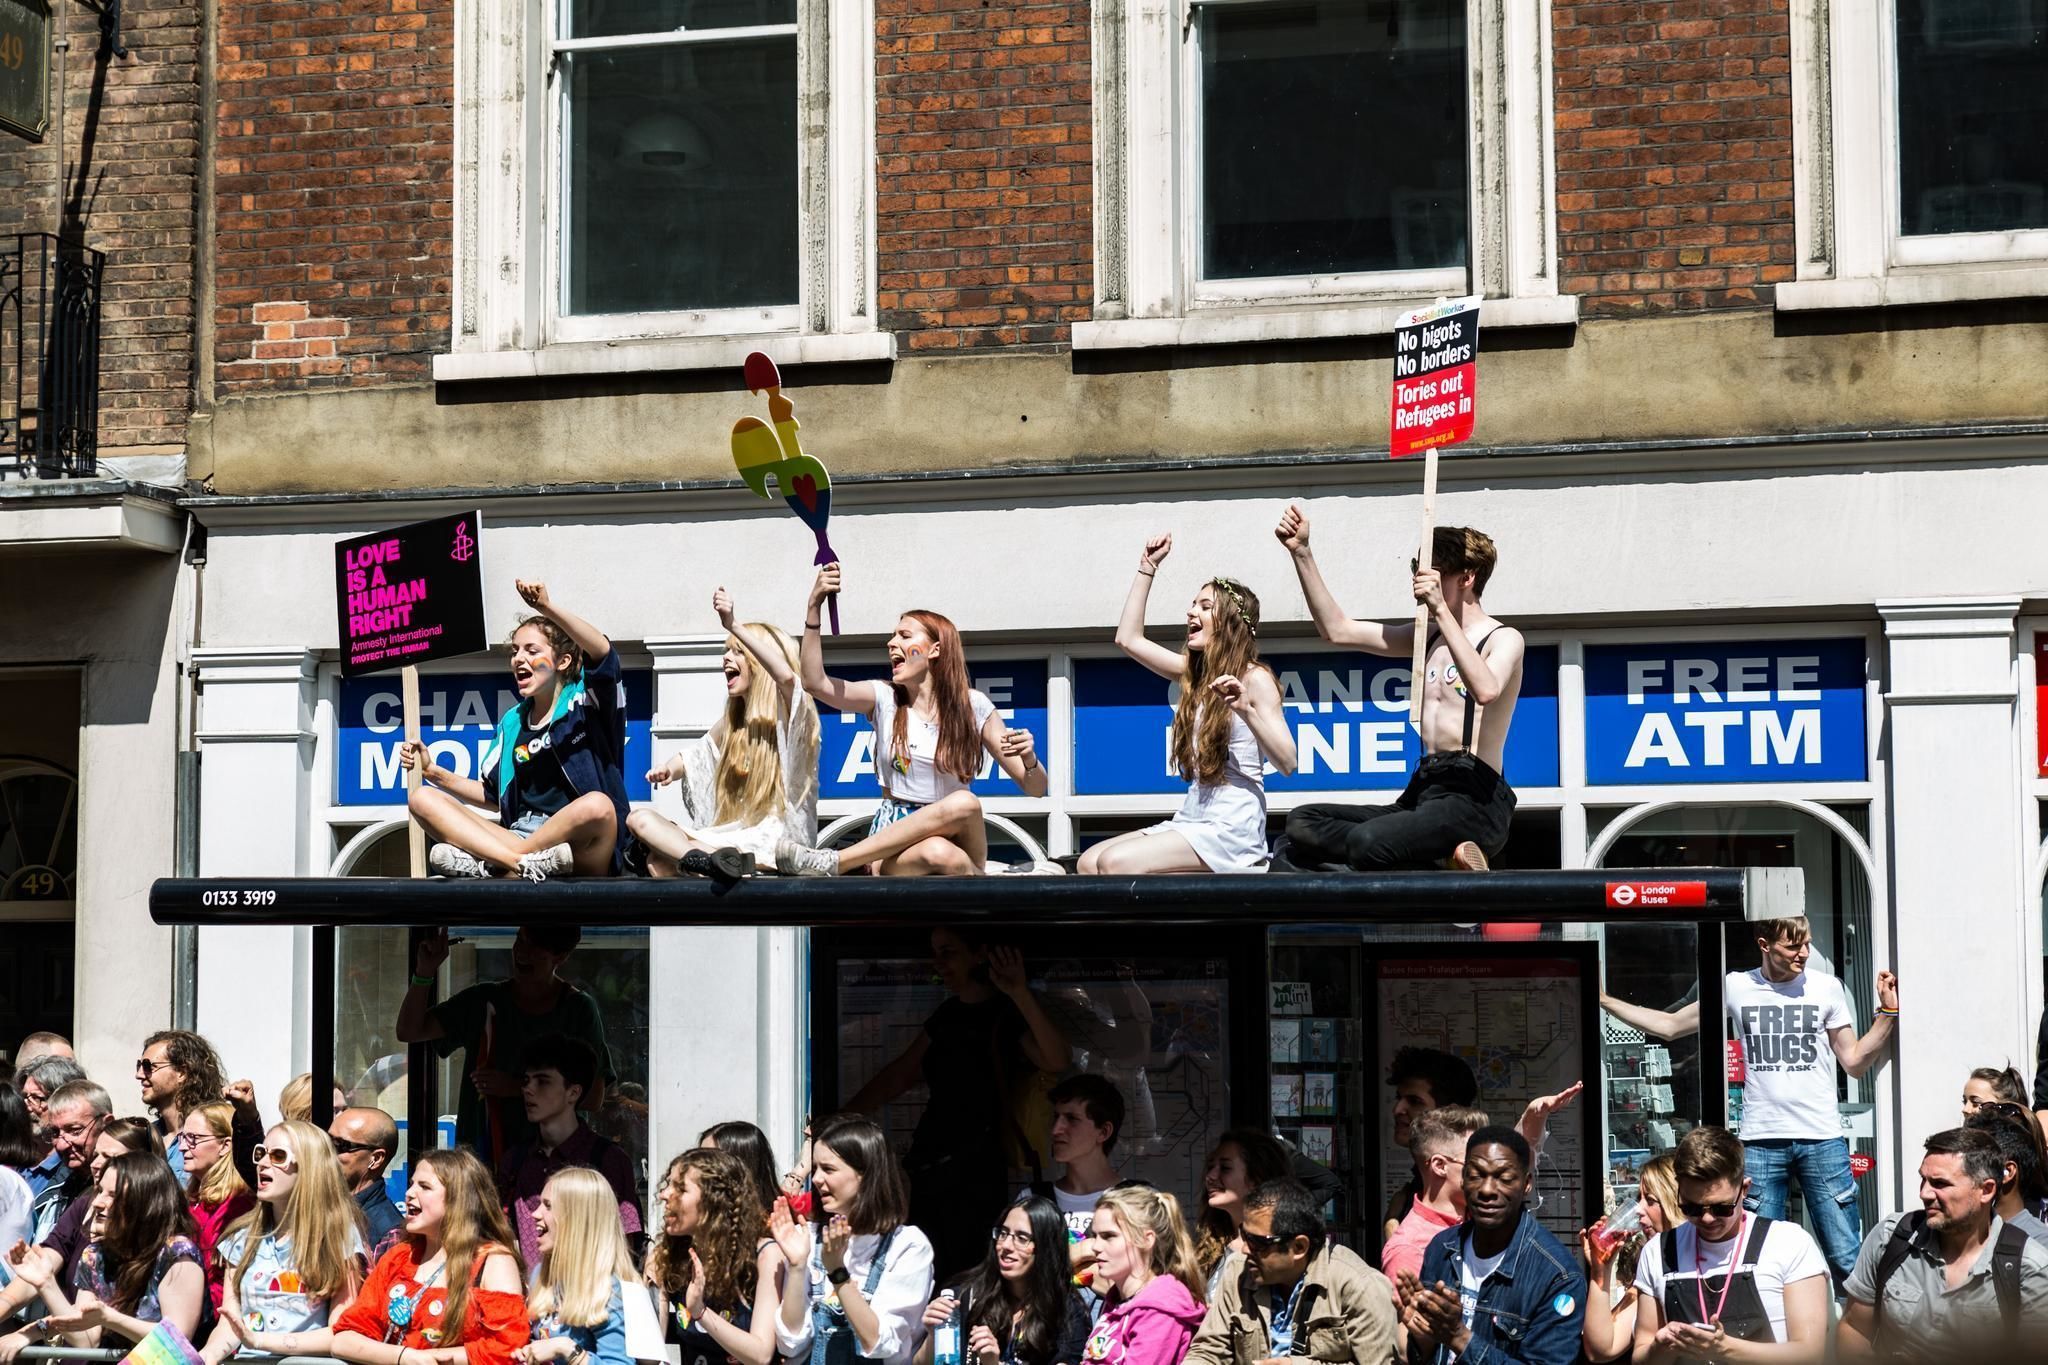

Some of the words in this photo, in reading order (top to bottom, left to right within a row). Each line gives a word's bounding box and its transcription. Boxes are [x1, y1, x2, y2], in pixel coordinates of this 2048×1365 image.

[0, 31, 25, 72] 49
[1398, 330, 1418, 352] No
[1422, 320, 1462, 349] bigots
[1397, 354, 1417, 376] No
[1420, 343, 1471, 372] borders
[1396, 380, 1437, 405] Tories
[1440, 371, 1463, 395] out
[1395, 400, 1456, 430] Refugees
[1458, 393, 1472, 415] in
[346, 539, 400, 571] LOVE
[347, 569, 367, 593] IS
[371, 565, 388, 588] A
[348, 578, 427, 615] HUMAN
[349, 604, 413, 637] RIGHT
[351, 637, 388, 653] Amnesty
[389, 623, 443, 645] International
[351, 650, 385, 665] PROTECT
[386, 647, 401, 657] THE
[402, 641, 430, 654] HUMAN
[1627, 656, 1822, 705] FREE
[1624, 709, 1822, 767] ATM
[21, 873, 54, 896] 49
[202, 890, 238, 906] 0133
[243, 890, 276, 906] 3919
[1641, 885, 1676, 895] London
[1641, 895, 1668, 904] Buses
[1741, 1004, 1819, 1034] FREE
[1745, 1034, 1817, 1064] HUGS
